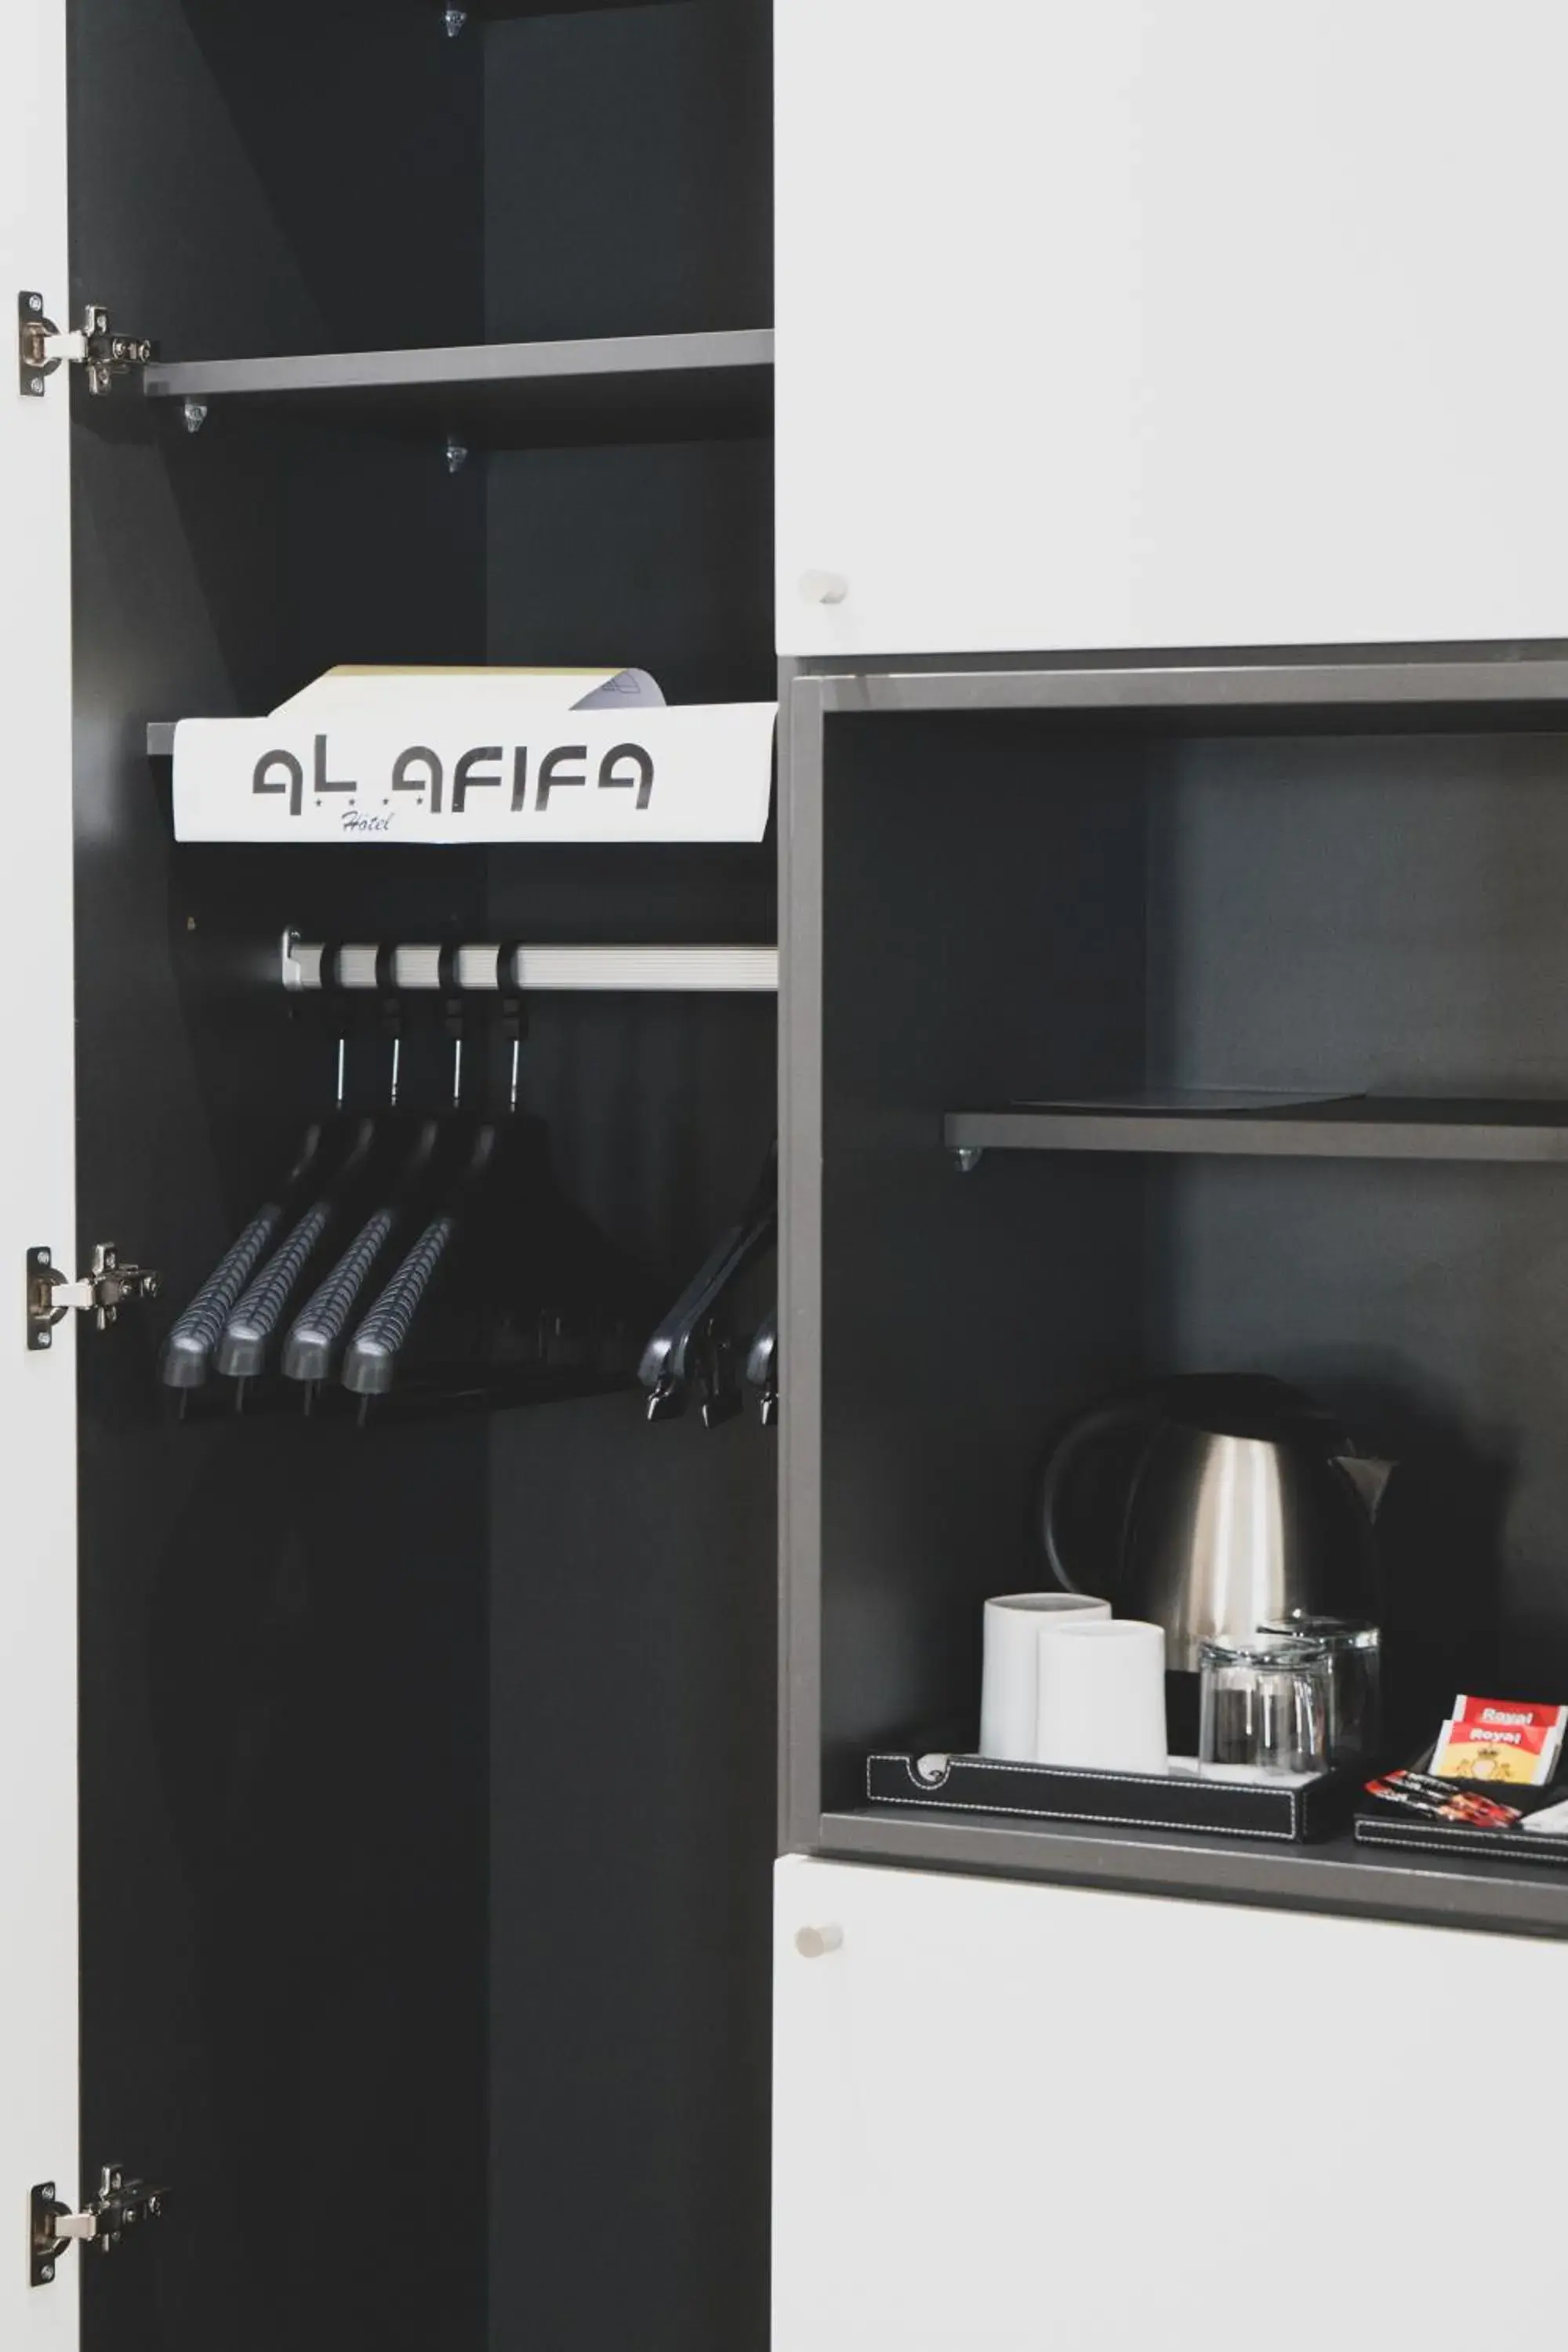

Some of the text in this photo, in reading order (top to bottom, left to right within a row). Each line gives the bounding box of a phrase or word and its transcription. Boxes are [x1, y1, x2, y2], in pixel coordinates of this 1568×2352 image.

[392, 743, 655, 813] AFIFA
[1482, 1708, 1533, 1724] Royal
[1469, 1728, 1522, 1744] Royal
